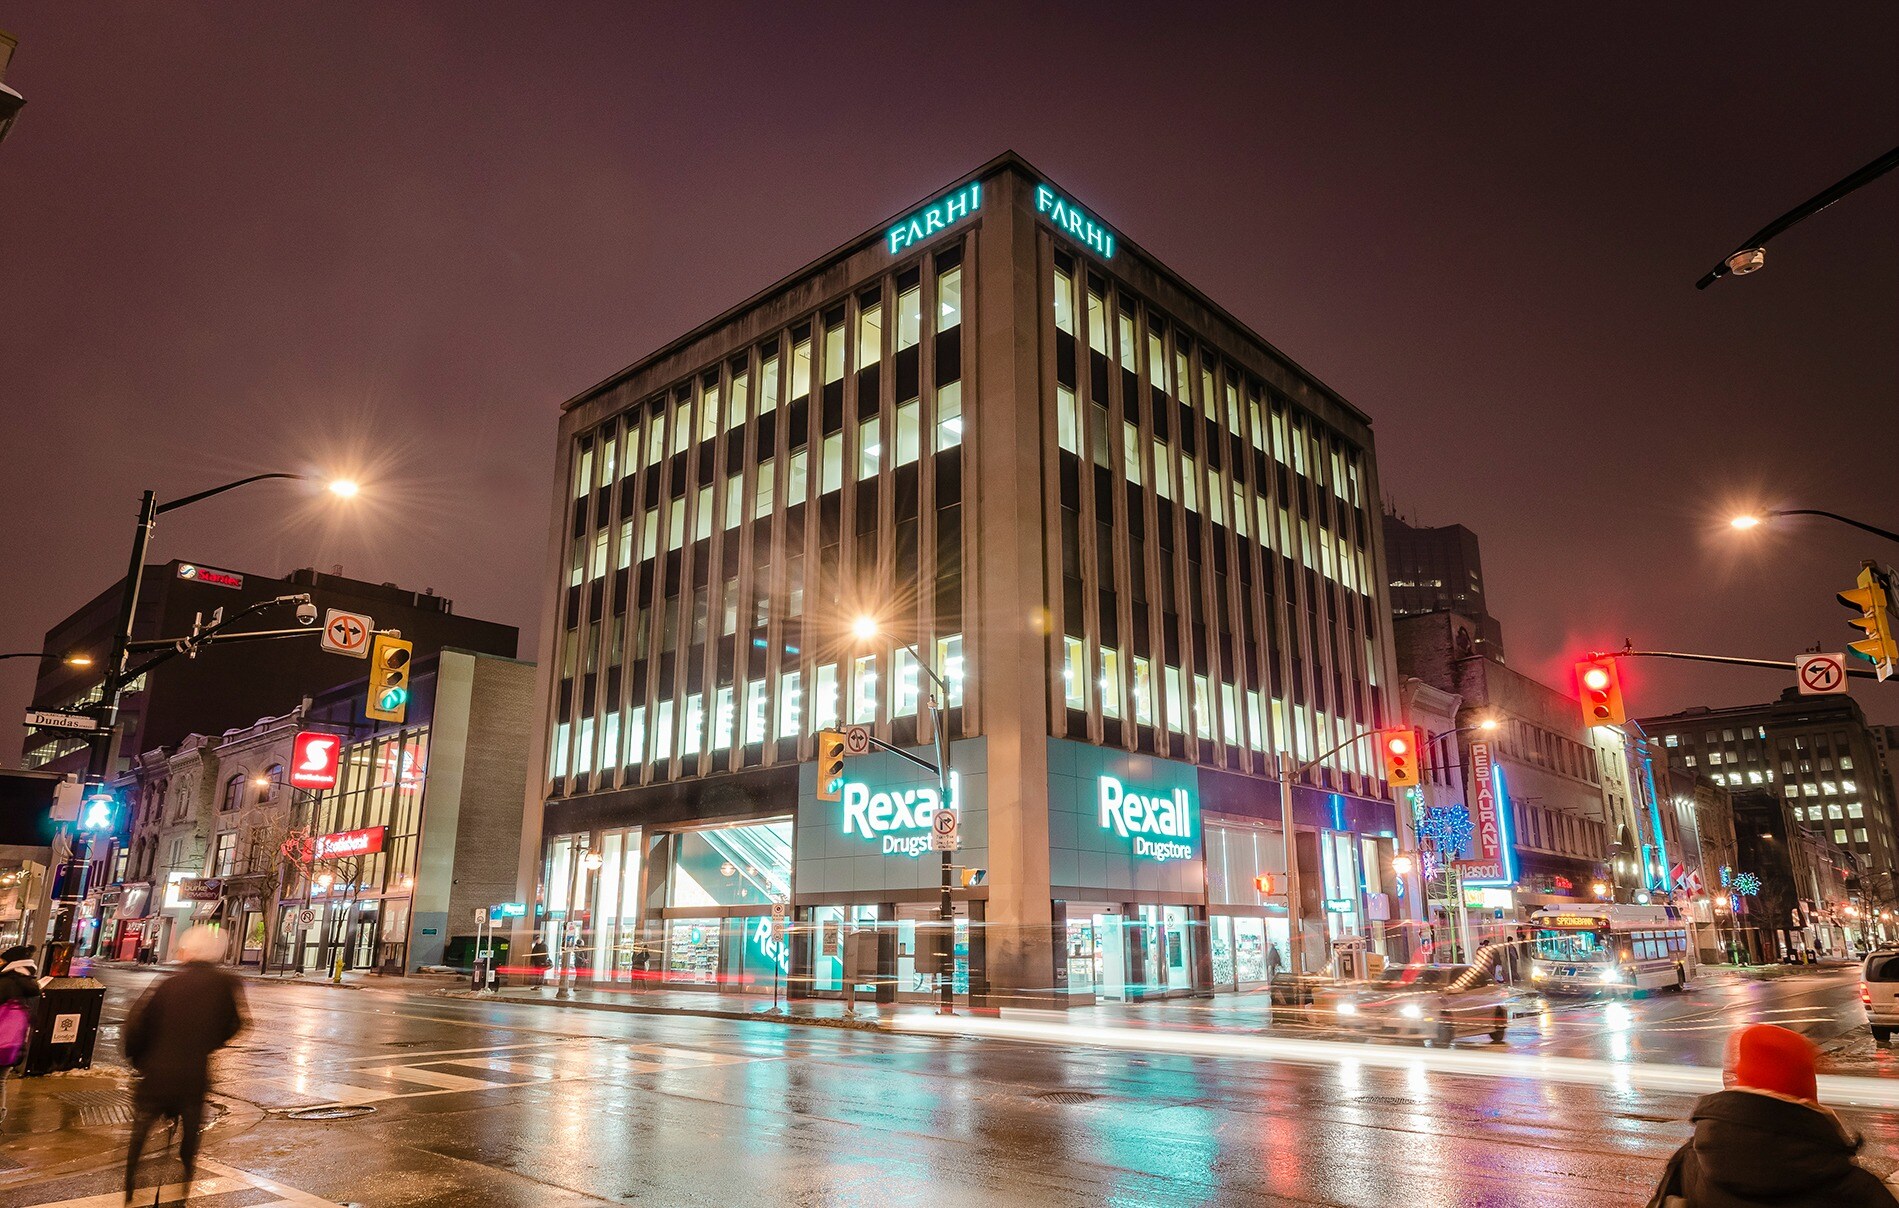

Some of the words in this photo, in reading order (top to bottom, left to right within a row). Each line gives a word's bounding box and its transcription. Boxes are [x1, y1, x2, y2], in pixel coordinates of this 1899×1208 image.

[889, 185, 981, 255] FARHI
[1037, 185, 1114, 259] FARHI
[197, 569, 240, 587] Stantec
[35, 714, 79, 728] Dundas
[842, 771, 960, 840] Rexal
[1099, 775, 1191, 838] Rexall
[1472, 744, 1499, 857] RESTAURANT
[1135, 837, 1192, 862] Drugstore
[184, 881, 208, 892] burke
[1456, 863, 1500, 880] Mascot
[1556, 916, 1594, 926] SPRINGBANK
[752, 915, 790, 975] Rex
